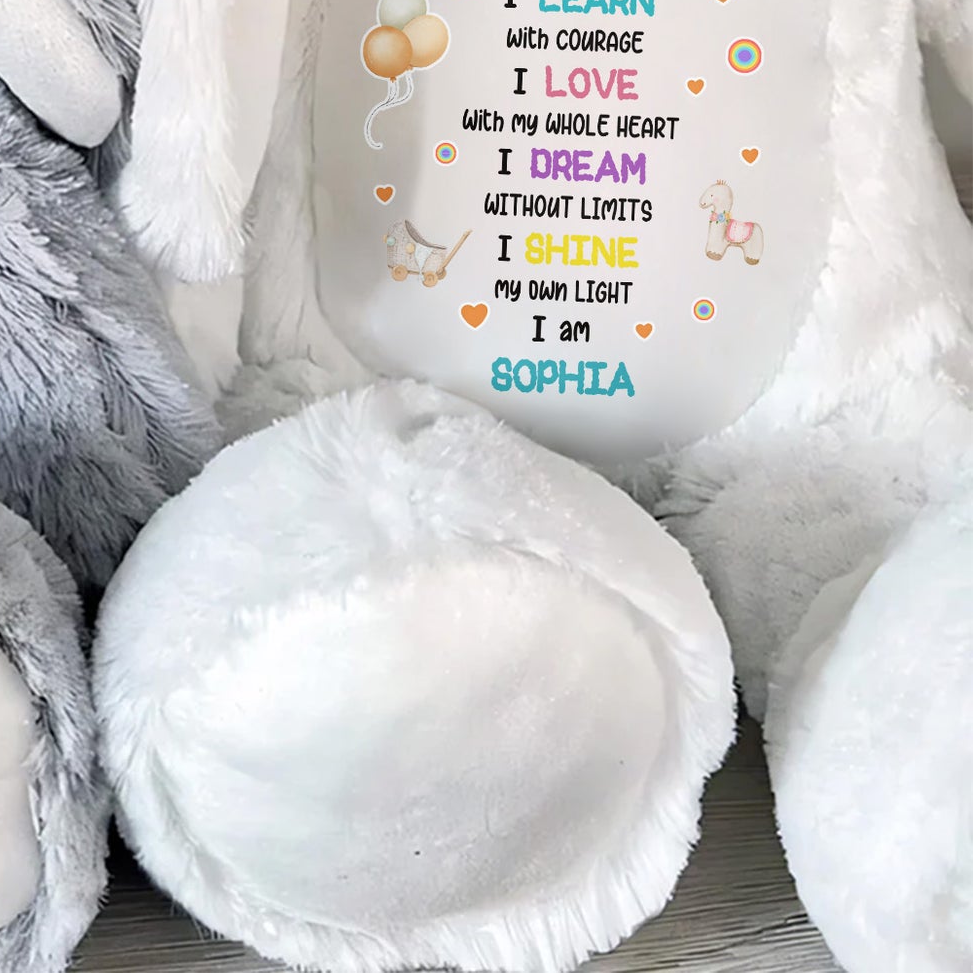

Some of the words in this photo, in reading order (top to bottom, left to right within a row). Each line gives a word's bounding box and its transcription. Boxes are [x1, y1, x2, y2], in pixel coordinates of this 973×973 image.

[556, 29, 644, 53] COURAGE
[514, 68, 528, 94] I
[546, 66, 638, 100] LOVE
[546, 112, 610, 136] WHOLE
[617, 116, 679, 139] HEART
[498, 149, 512, 175] I
[530, 148, 646, 184] DREAM
[484, 193, 573, 218] WITHOUT
[581, 197, 652, 222] LIMITS
[498, 235, 512, 261] I
[525, 232, 639, 268] SHINE
[575, 280, 633, 304] LIGHT
[532, 315, 546, 342] I
[560, 321, 590, 342] am
[491, 357, 635, 397] SOPHIA
